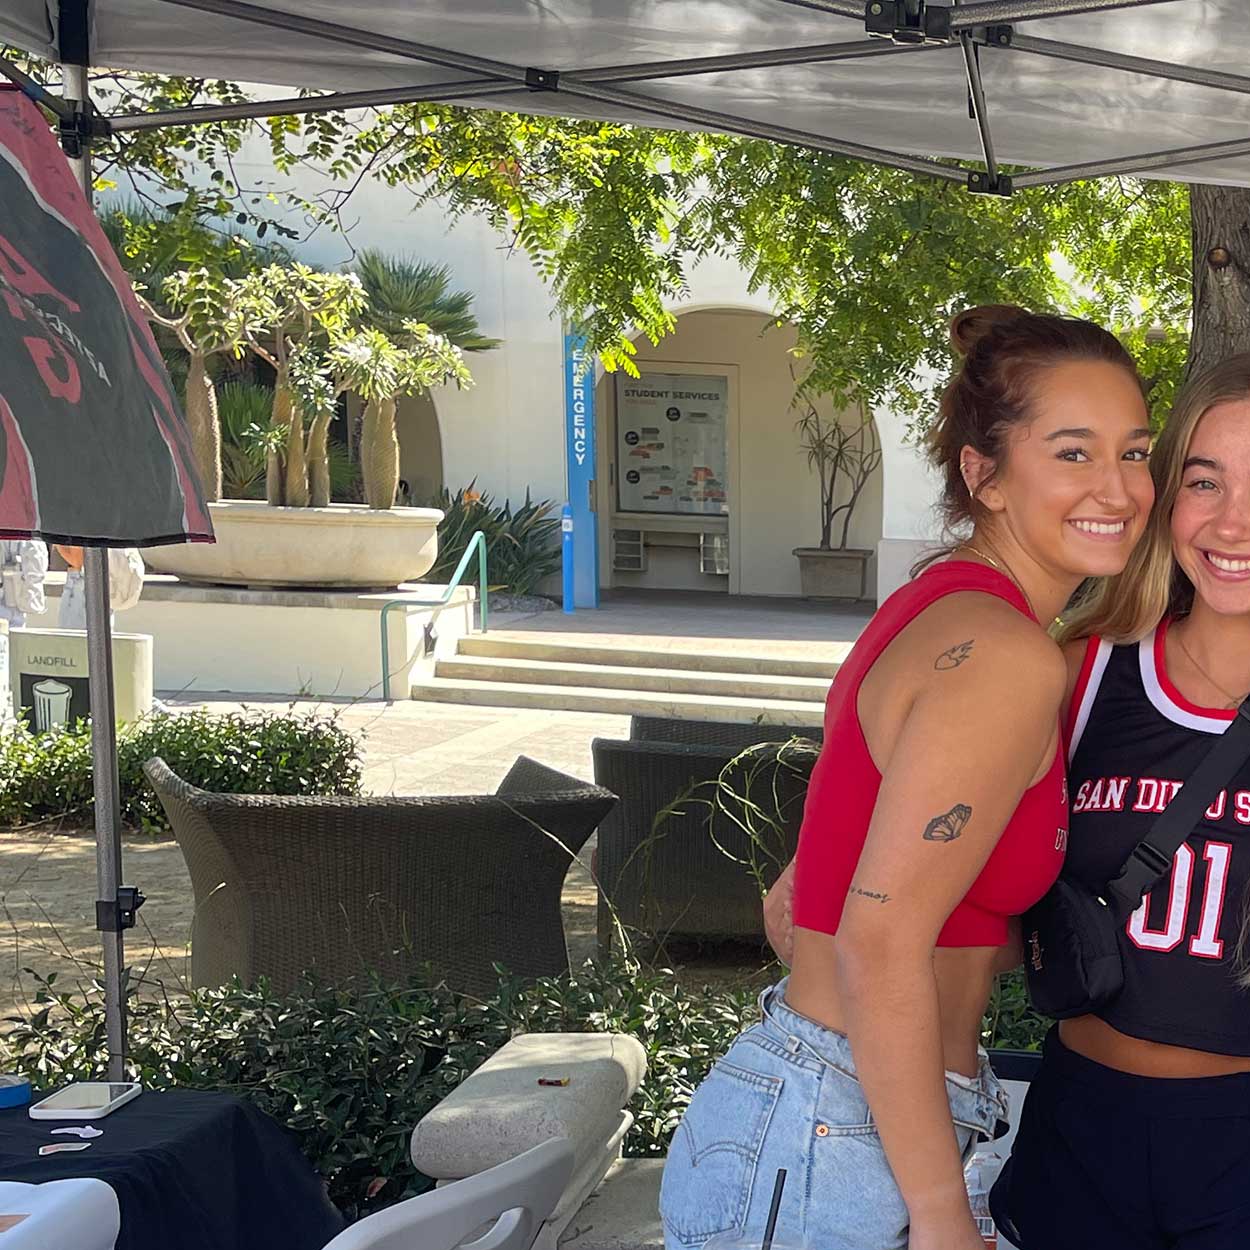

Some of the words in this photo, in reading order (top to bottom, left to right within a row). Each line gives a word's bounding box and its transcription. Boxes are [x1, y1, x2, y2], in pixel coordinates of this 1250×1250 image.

[624, 389, 670, 399] STUDENT
[673, 391, 720, 401] SERVICES
[27, 655, 77, 668] LANDFILL
[1073, 776, 1131, 814] SAN
